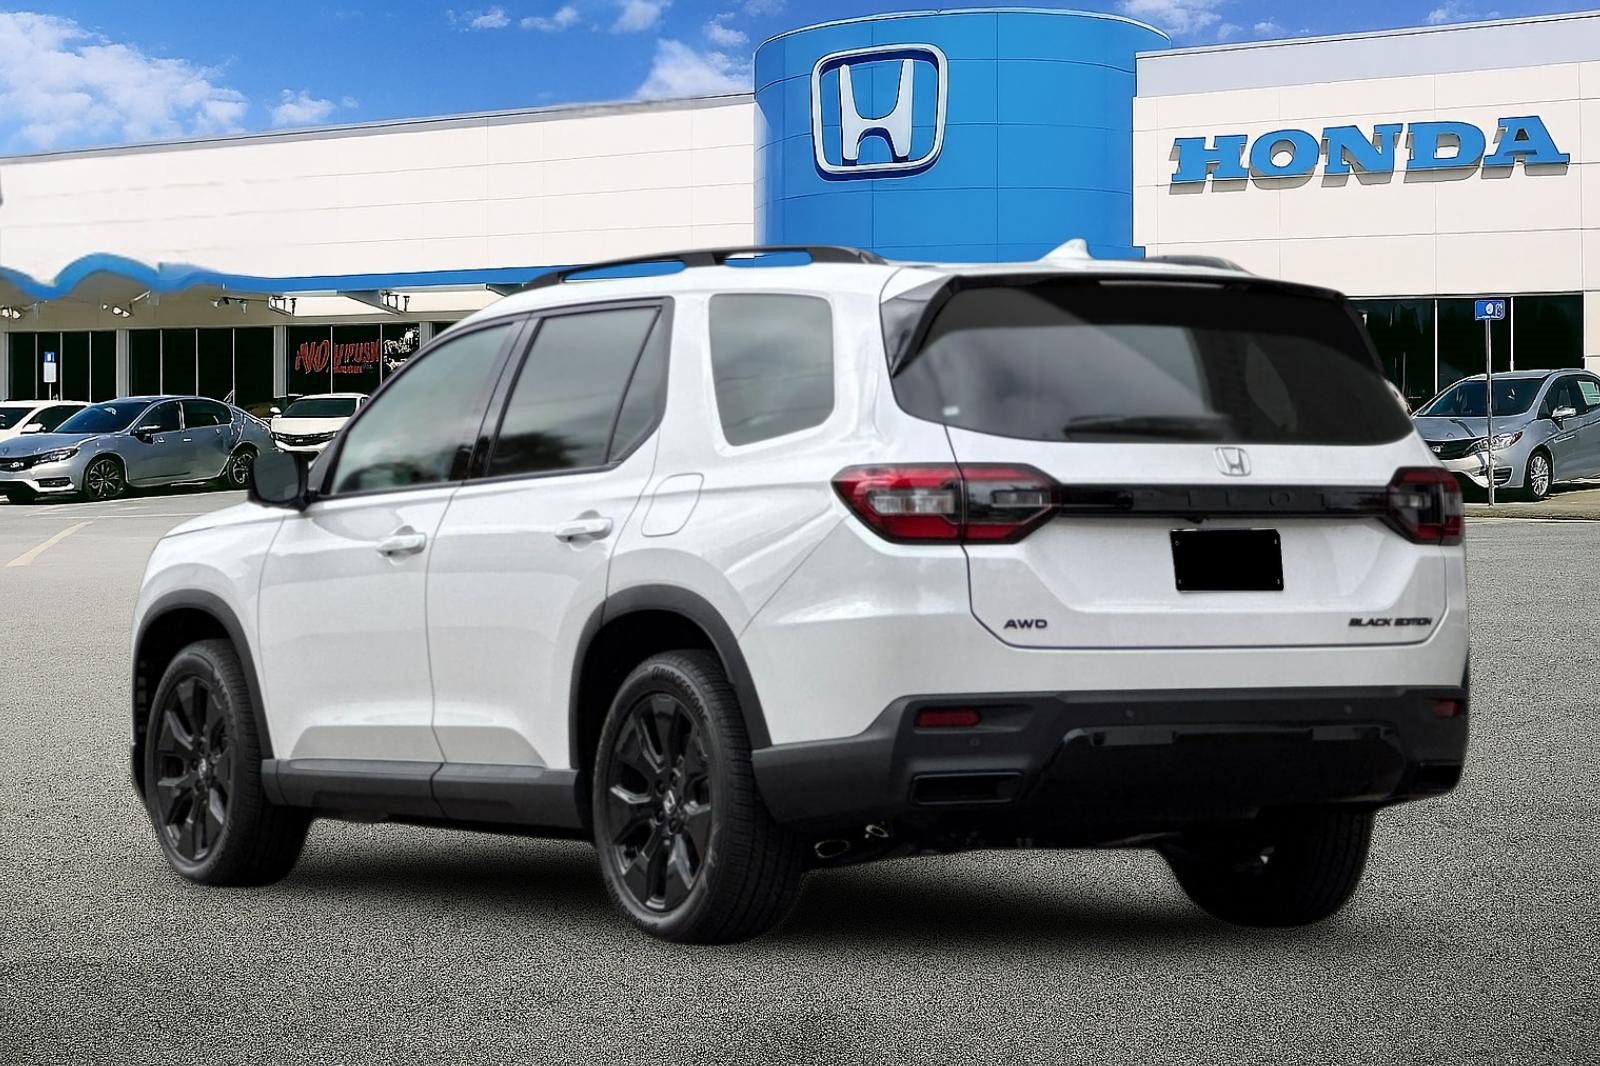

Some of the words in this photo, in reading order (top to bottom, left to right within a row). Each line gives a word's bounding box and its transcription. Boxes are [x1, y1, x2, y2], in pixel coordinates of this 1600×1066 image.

[1170, 115, 1570, 188] HONDA
[1003, 618, 1048, 630] AWD
[1349, 617, 1392, 628] BLACK
